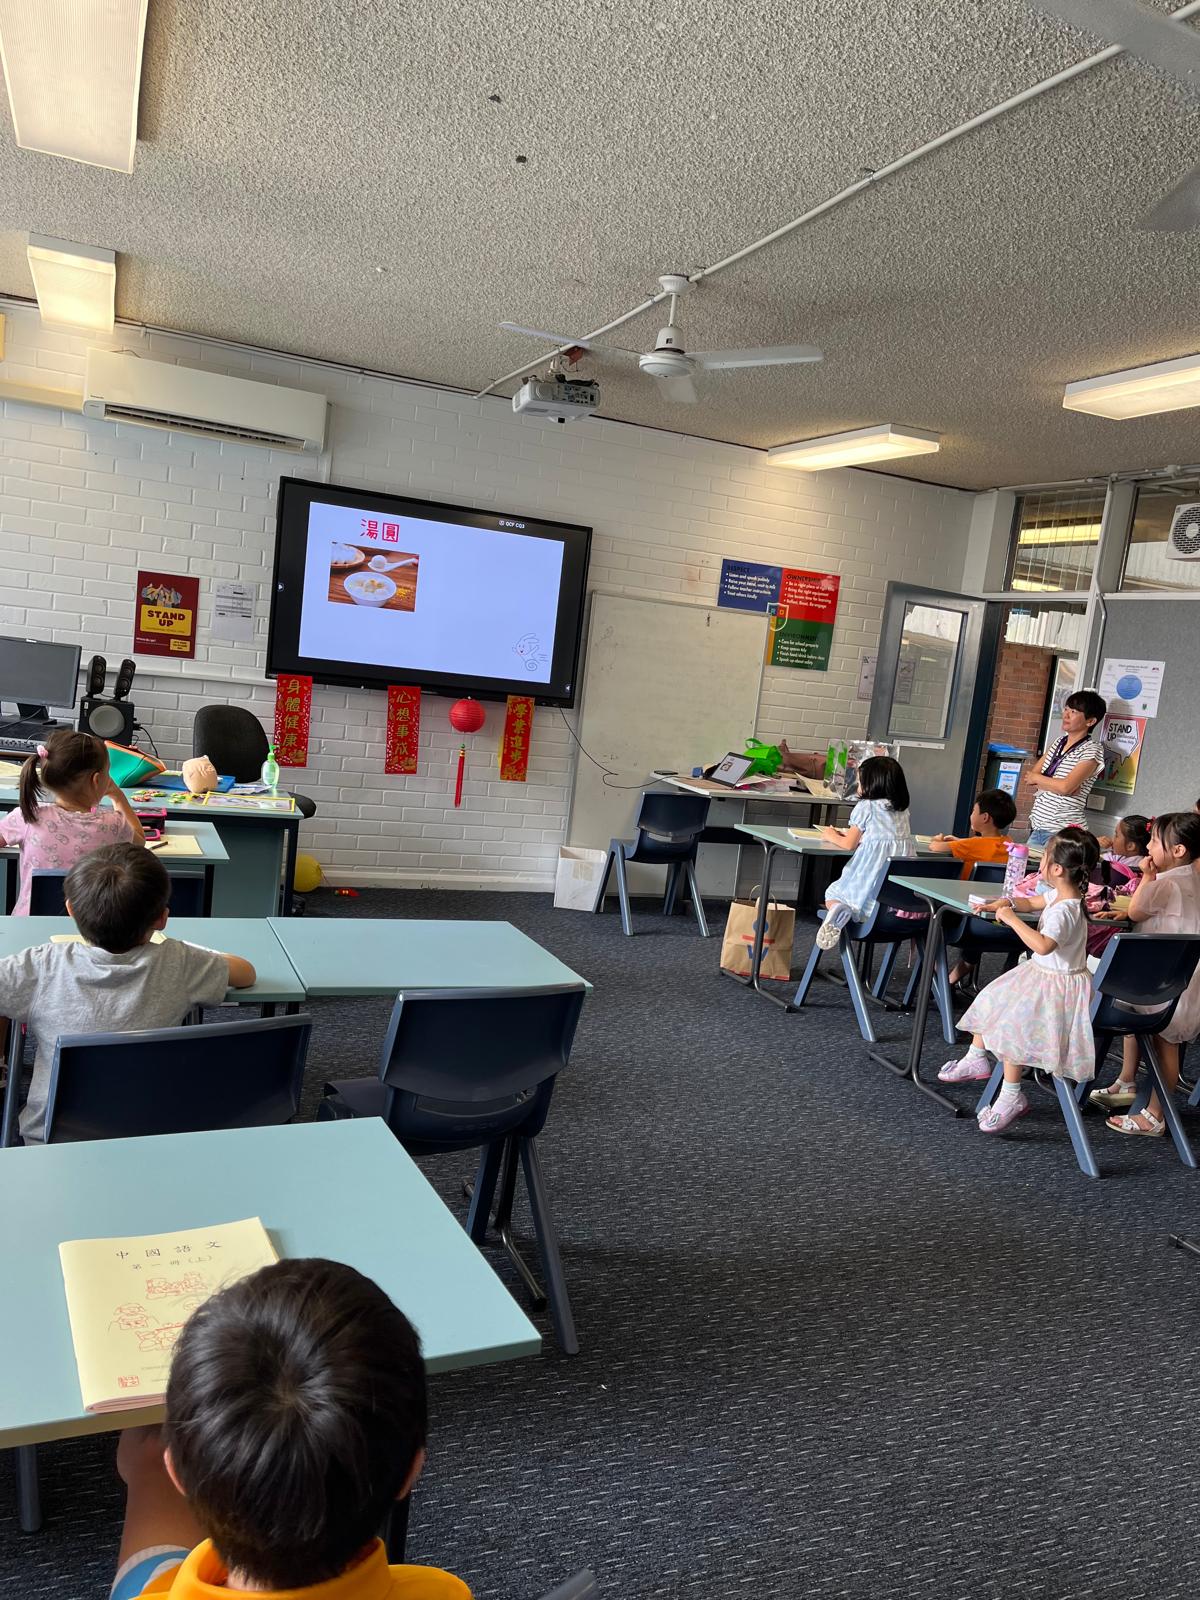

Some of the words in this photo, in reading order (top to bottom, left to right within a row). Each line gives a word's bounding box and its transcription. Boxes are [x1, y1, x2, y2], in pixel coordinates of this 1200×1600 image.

[360, 519, 400, 542] 湯圓
[147, 610, 186, 620] STAND
[158, 618, 174, 627] UP
[282, 679, 301, 747] 身體健康
[395, 690, 412, 756] 心想事成
[1109, 723, 1132, 733] STAND
[506, 703, 528, 767] 學業進步
[1107, 733, 1116, 741] UP
[116, 1241, 222, 1260] 中國語文
